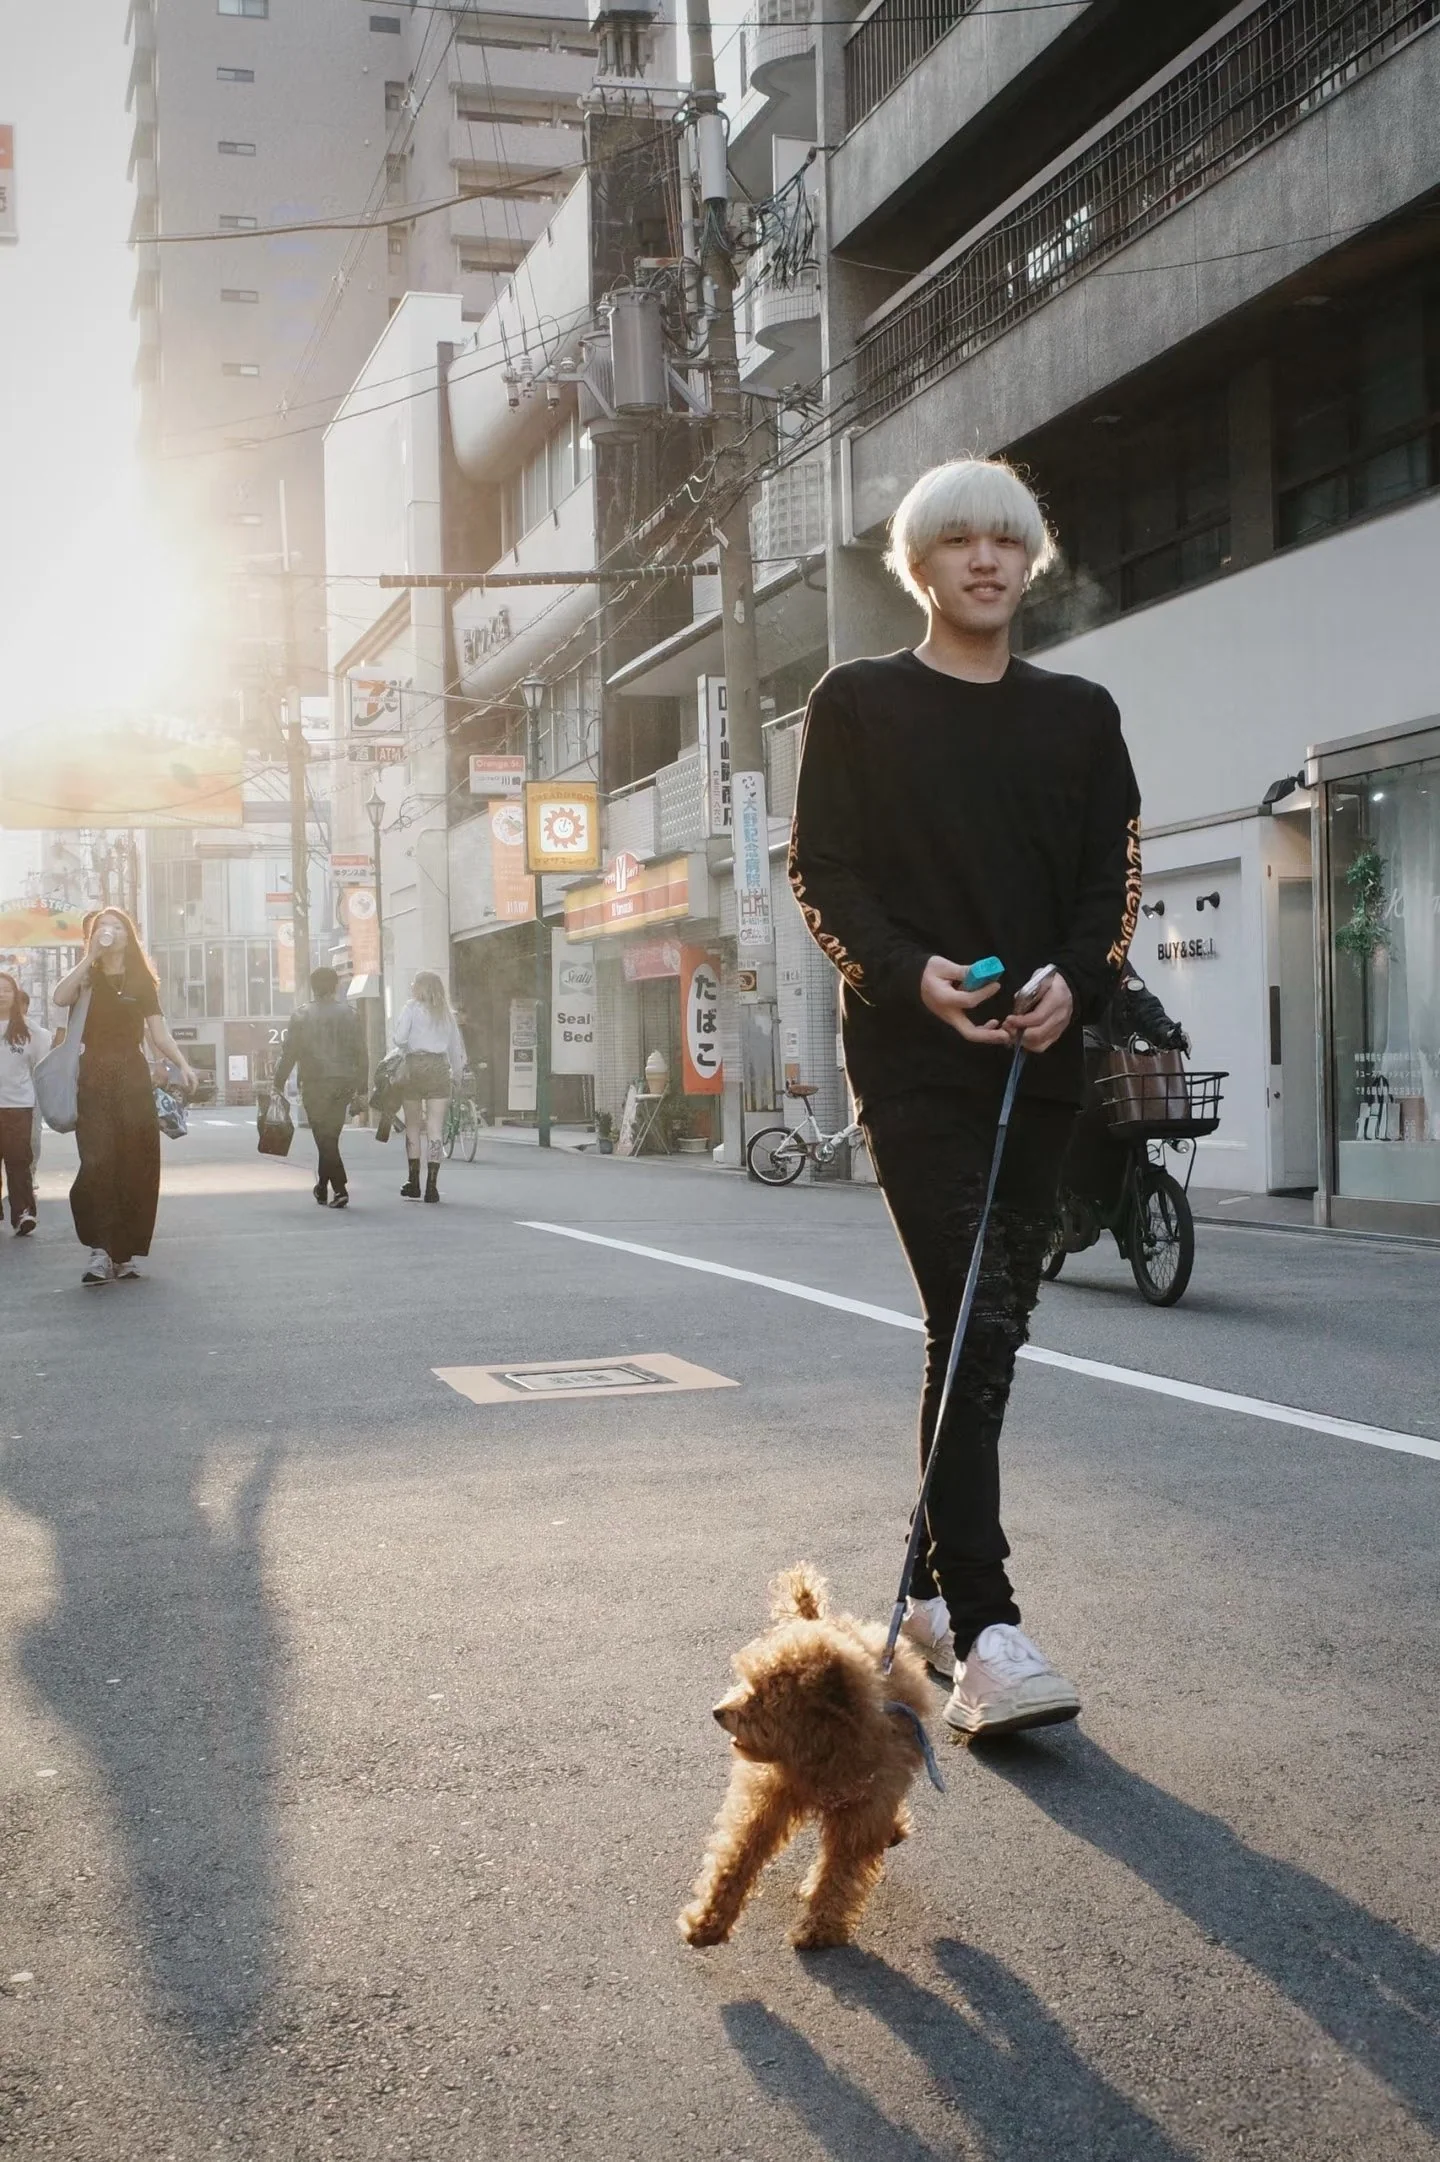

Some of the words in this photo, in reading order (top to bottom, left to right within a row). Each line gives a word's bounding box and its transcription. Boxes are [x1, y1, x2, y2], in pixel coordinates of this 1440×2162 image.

[557, 1013, 593, 1025] Seal
[695, 974, 717, 1067] たばこ
